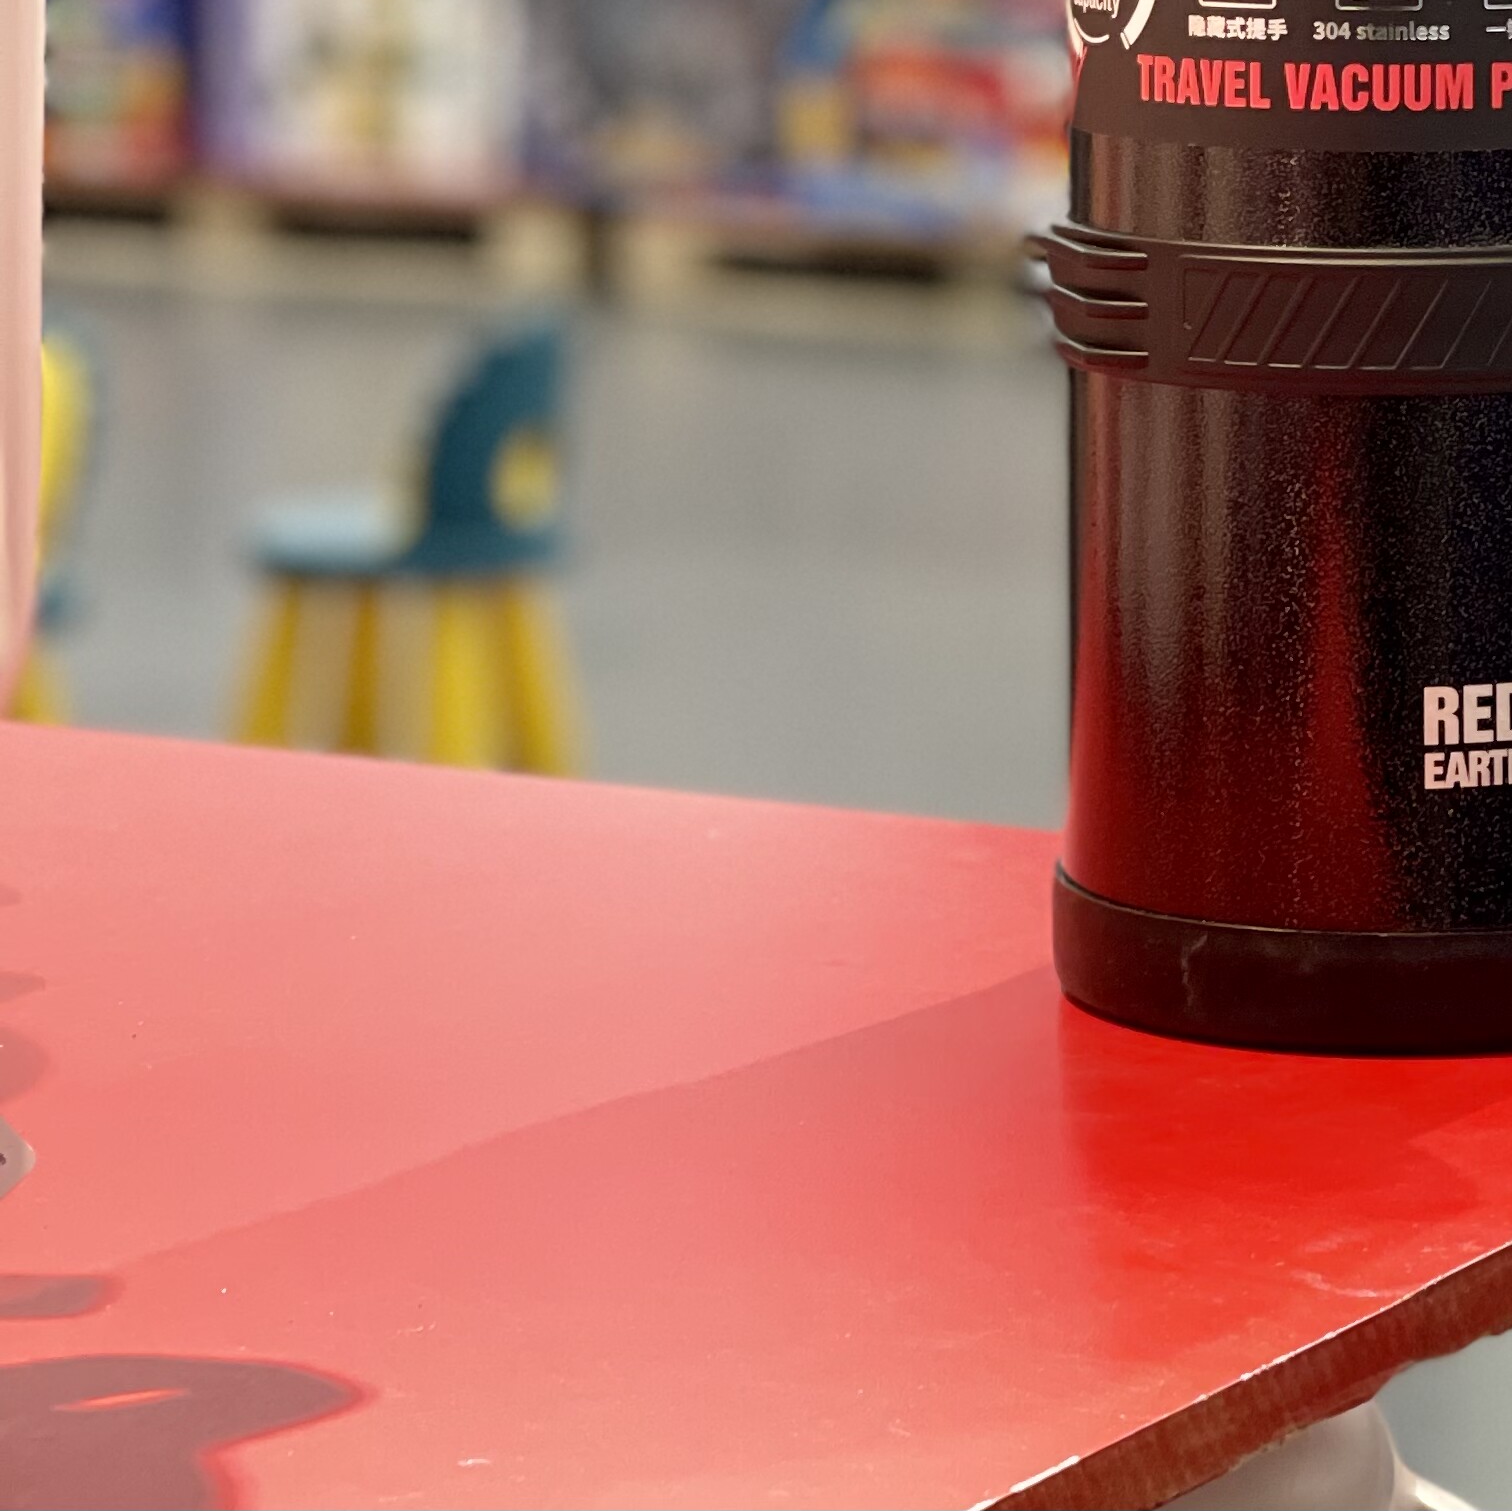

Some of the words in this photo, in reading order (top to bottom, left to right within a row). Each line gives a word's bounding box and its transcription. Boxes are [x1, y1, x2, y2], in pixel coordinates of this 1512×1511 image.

[1312, 21, 1351, 40] 304
[1356, 21, 1450, 41] stainless
[1137, 54, 1271, 109] TRAVEL
[1284, 62, 1474, 111] VACUUM
